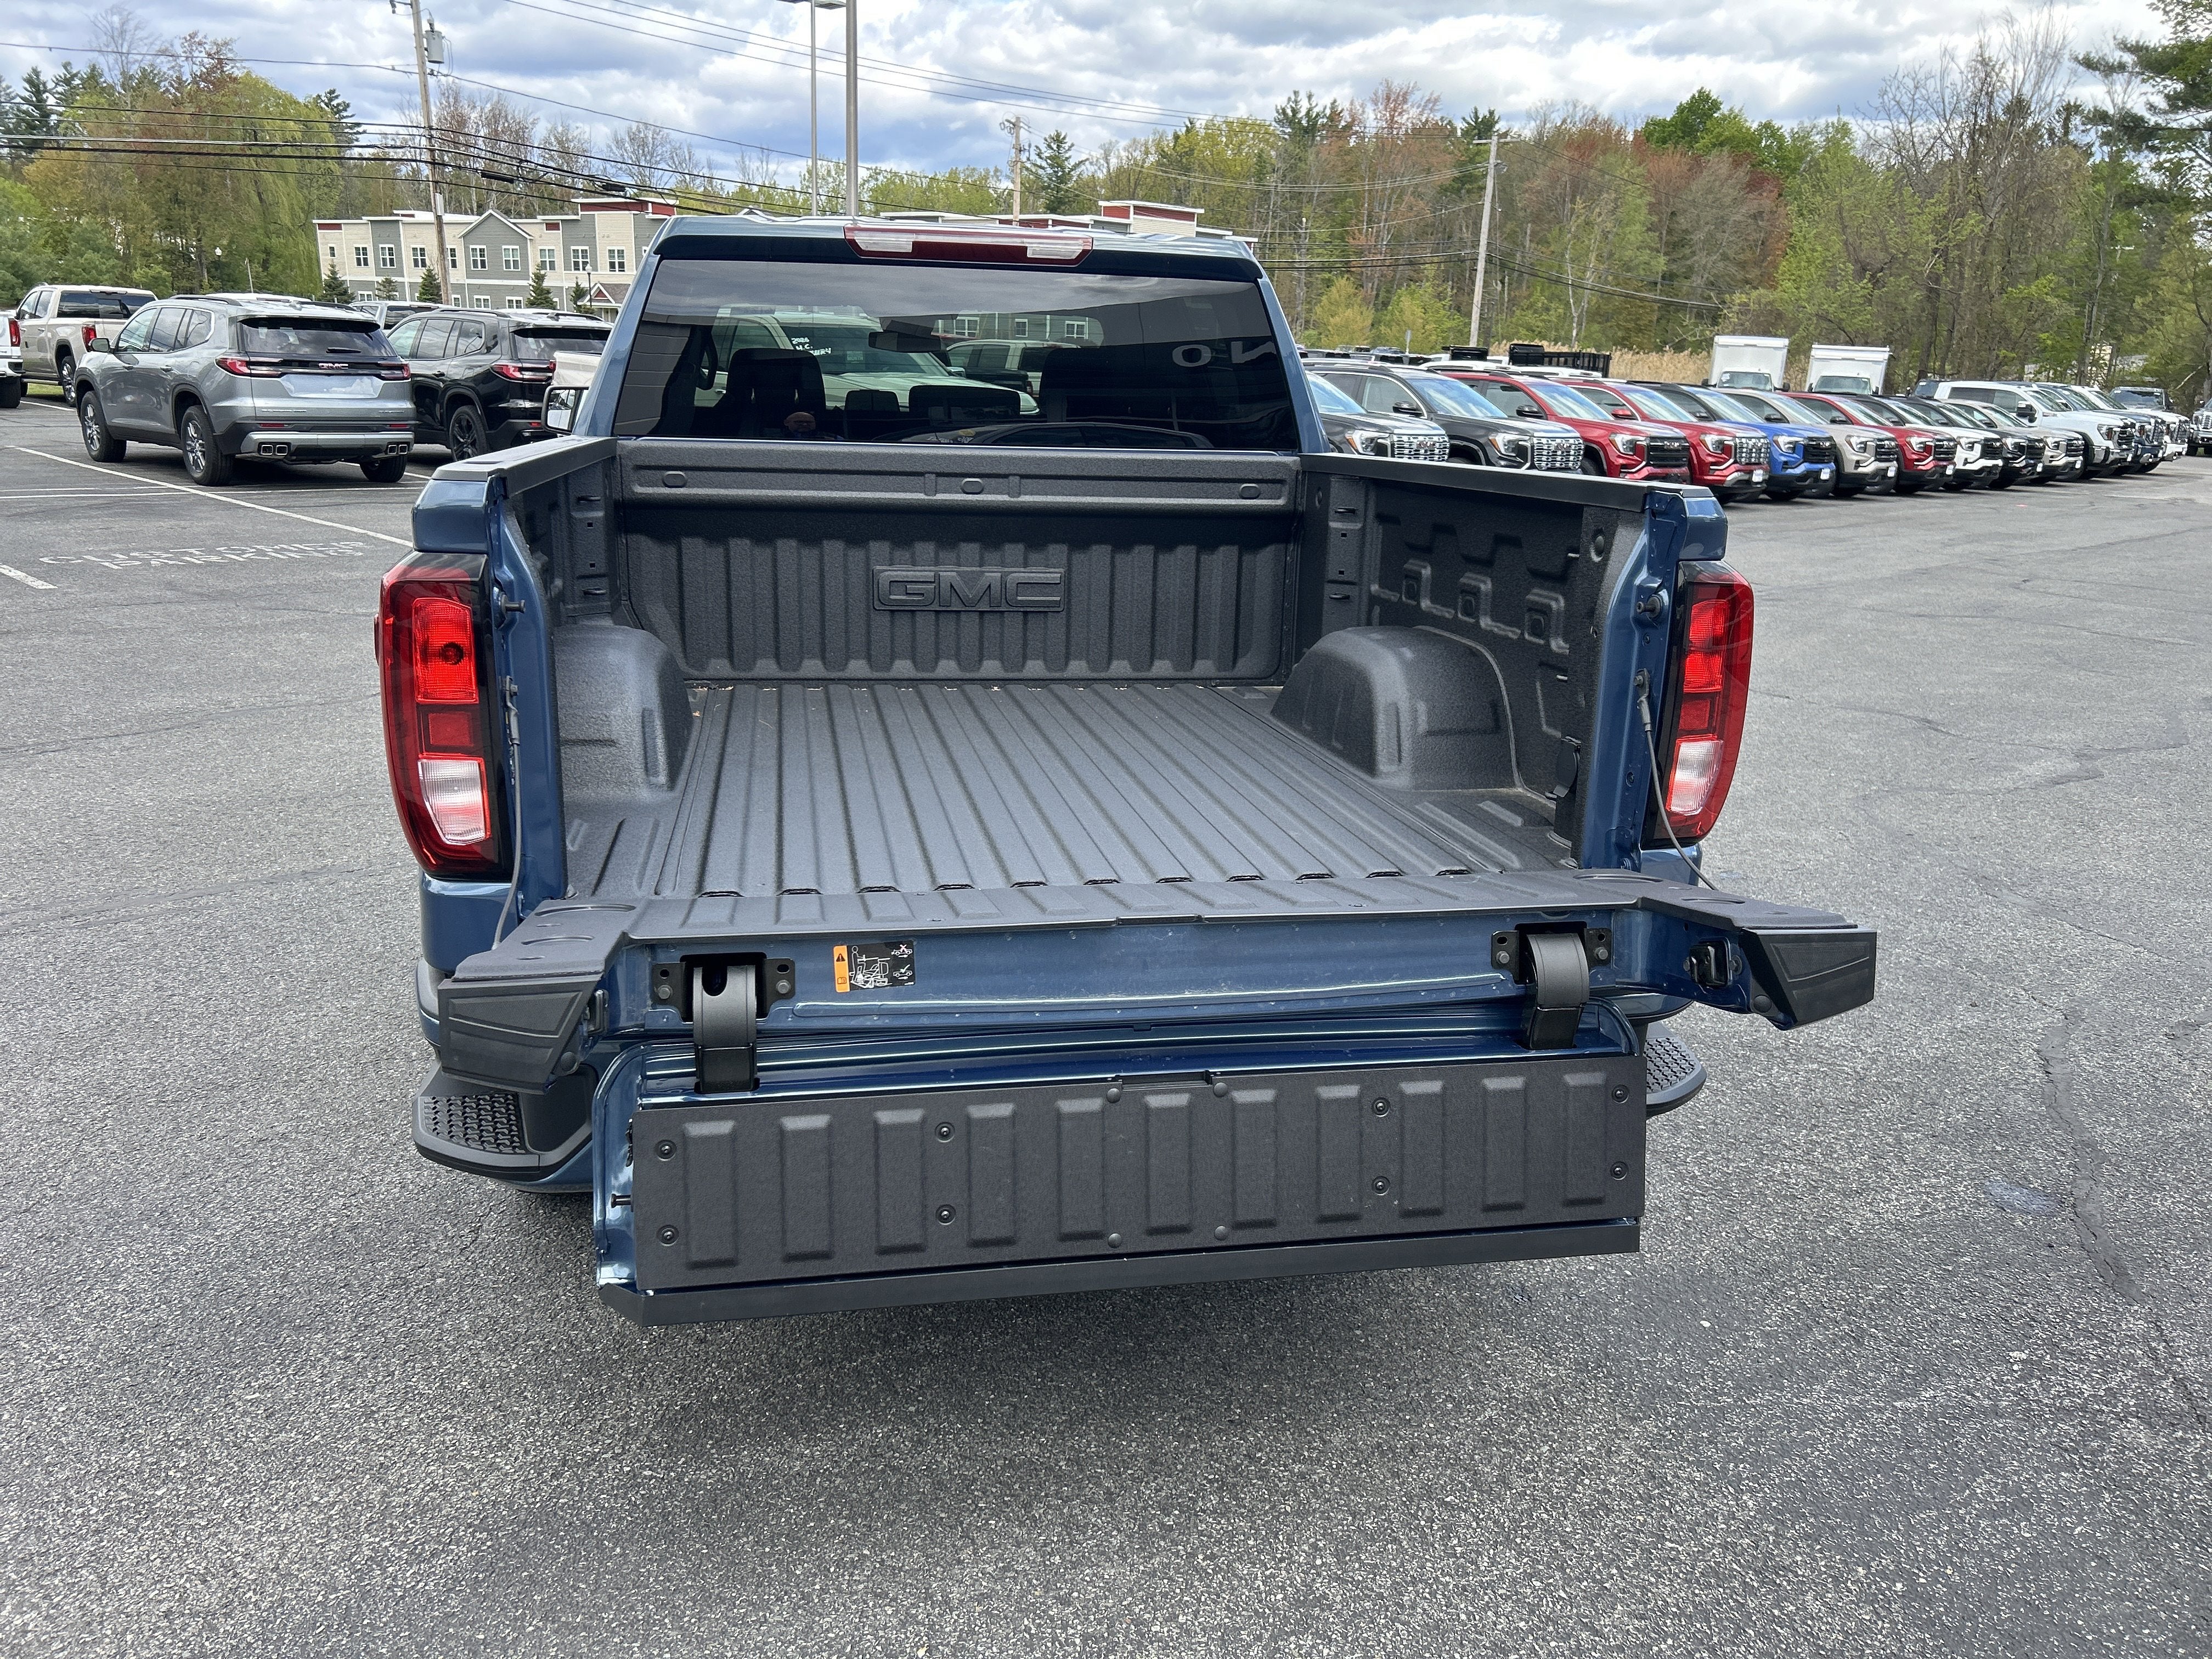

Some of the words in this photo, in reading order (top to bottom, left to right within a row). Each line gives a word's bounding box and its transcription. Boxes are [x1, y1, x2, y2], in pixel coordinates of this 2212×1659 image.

[39, 541, 364, 563] CUSTOMER
[100, 550, 364, 569] PARKING
[878, 571, 1061, 607] GMC
